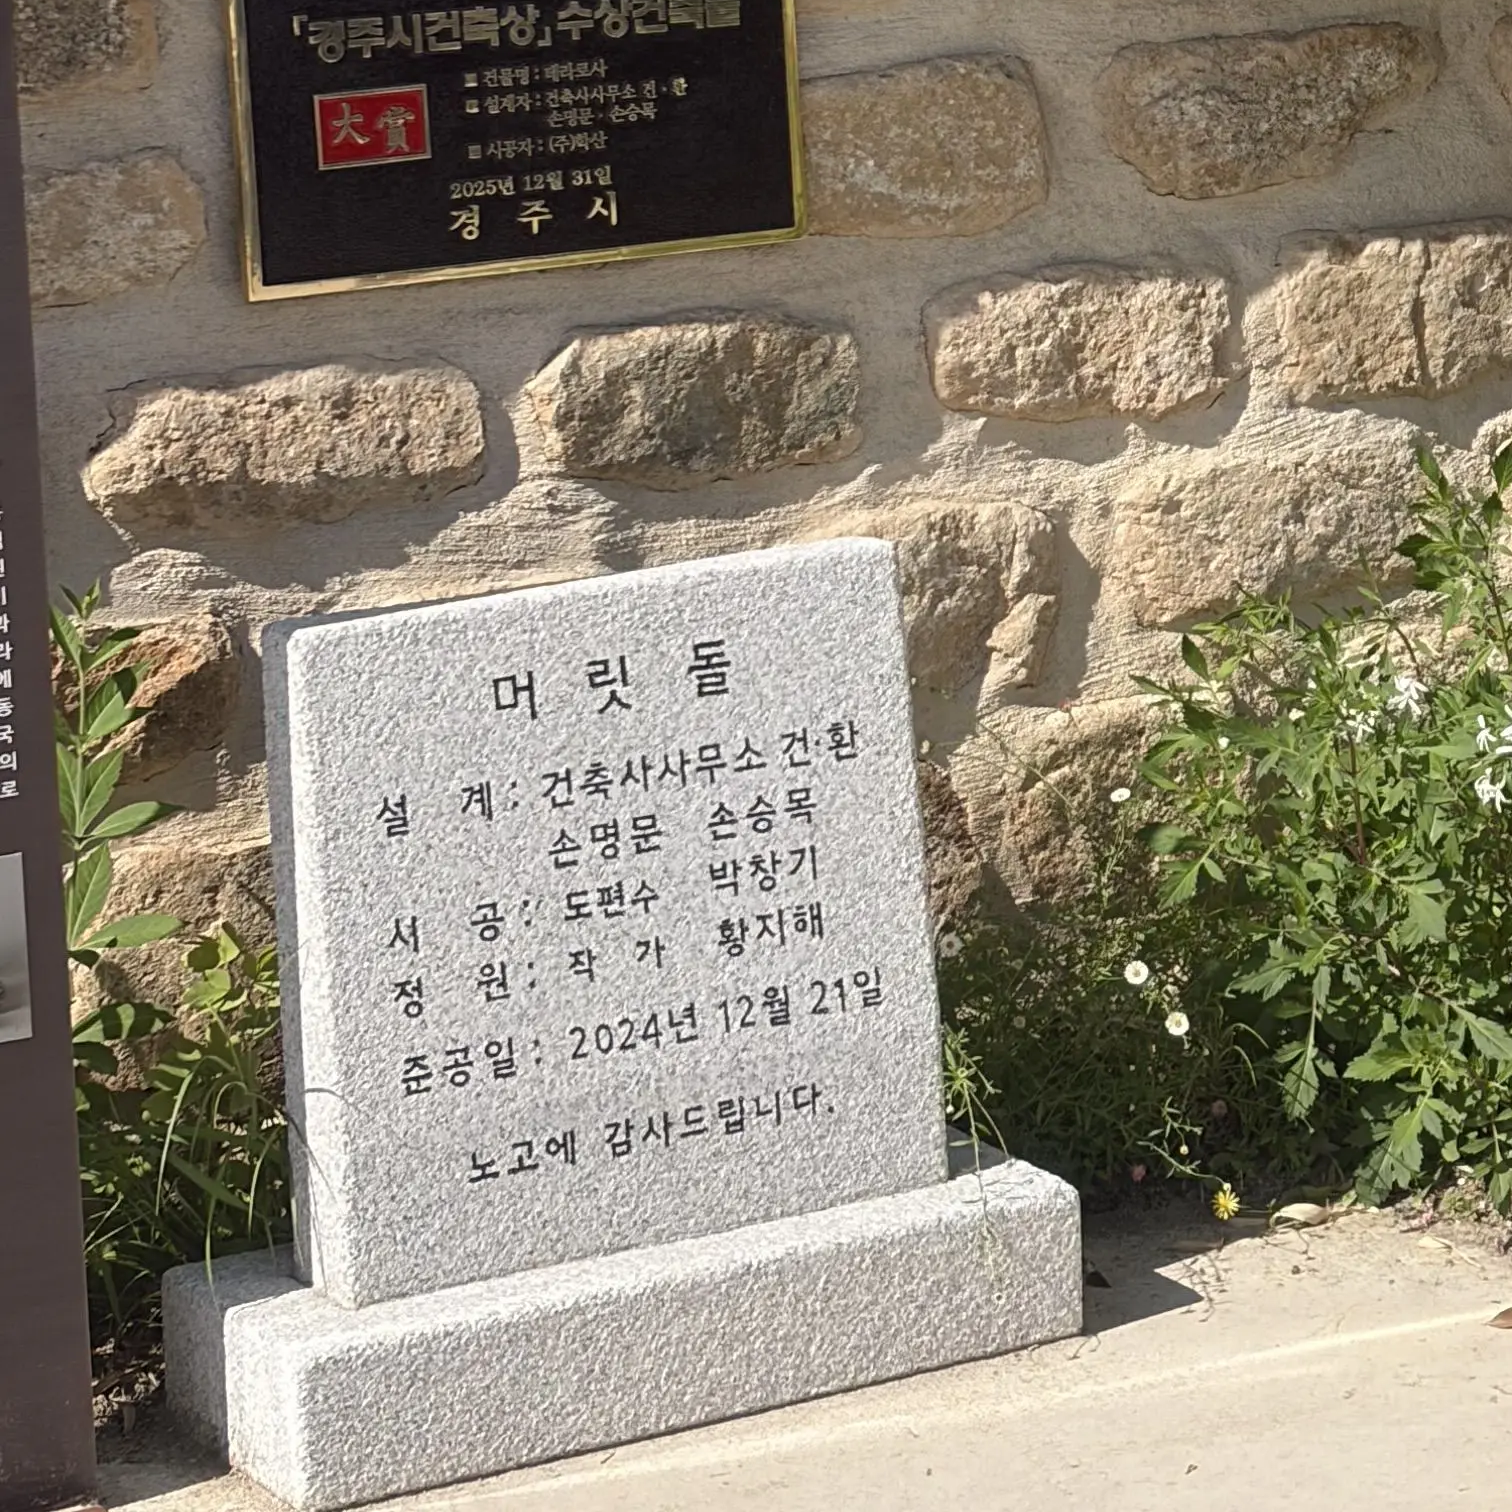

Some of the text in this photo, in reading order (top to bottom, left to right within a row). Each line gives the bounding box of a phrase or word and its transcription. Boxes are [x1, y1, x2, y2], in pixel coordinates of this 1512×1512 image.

[450, 165, 613, 200] 2025년 12월 31일
[541, 737, 768, 809] 건축사사무소
[548, 787, 818, 869] 손명문 손승목
[564, 879, 660, 921] 도편수
[708, 844, 819, 897] 박창기
[717, 900, 825, 958] 황지해
[568, 1001, 700, 1060] 2024년
[717, 985, 792, 1034] 12월
[809, 966, 884, 1015] 21일
[468, 1081, 836, 1184] 노고에 감사드립니다.
